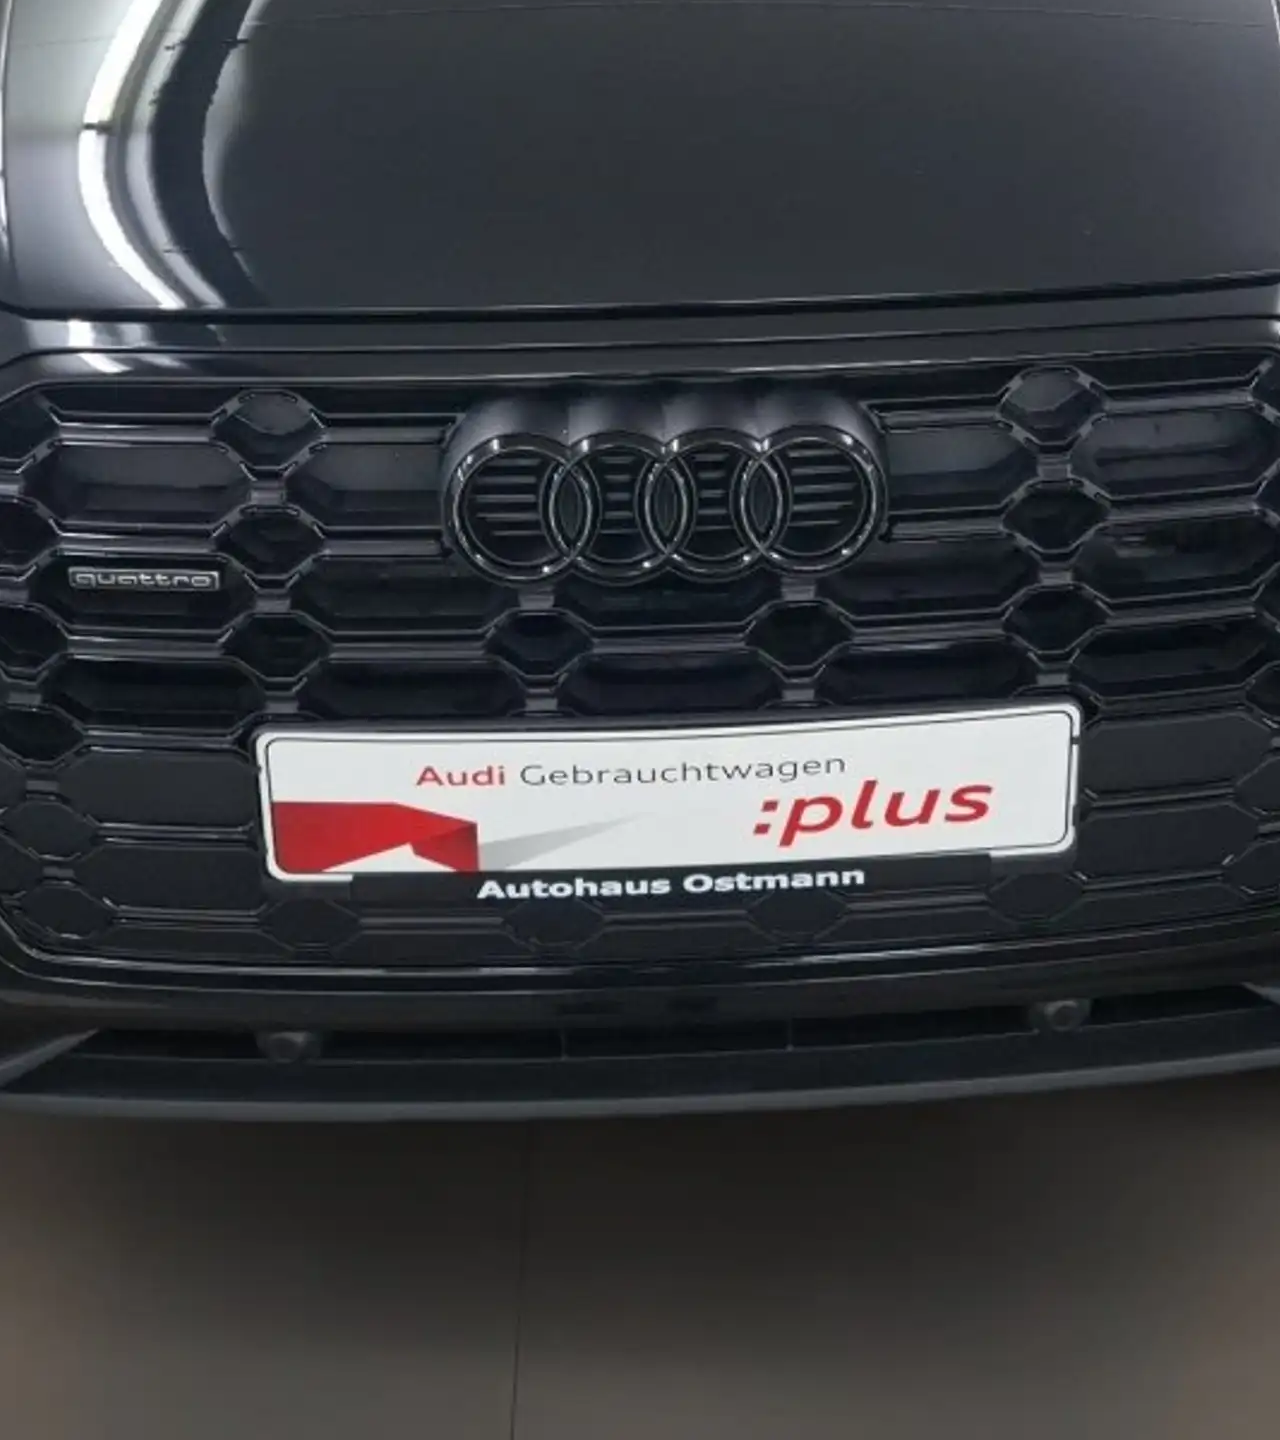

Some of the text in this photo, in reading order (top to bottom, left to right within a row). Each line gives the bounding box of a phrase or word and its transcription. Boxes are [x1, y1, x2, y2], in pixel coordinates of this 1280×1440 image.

[74, 571, 212, 587] quattro
[415, 754, 847, 788] Audi Gebrauchtwagen
[477, 865, 865, 900] Autohaus Ostmann
